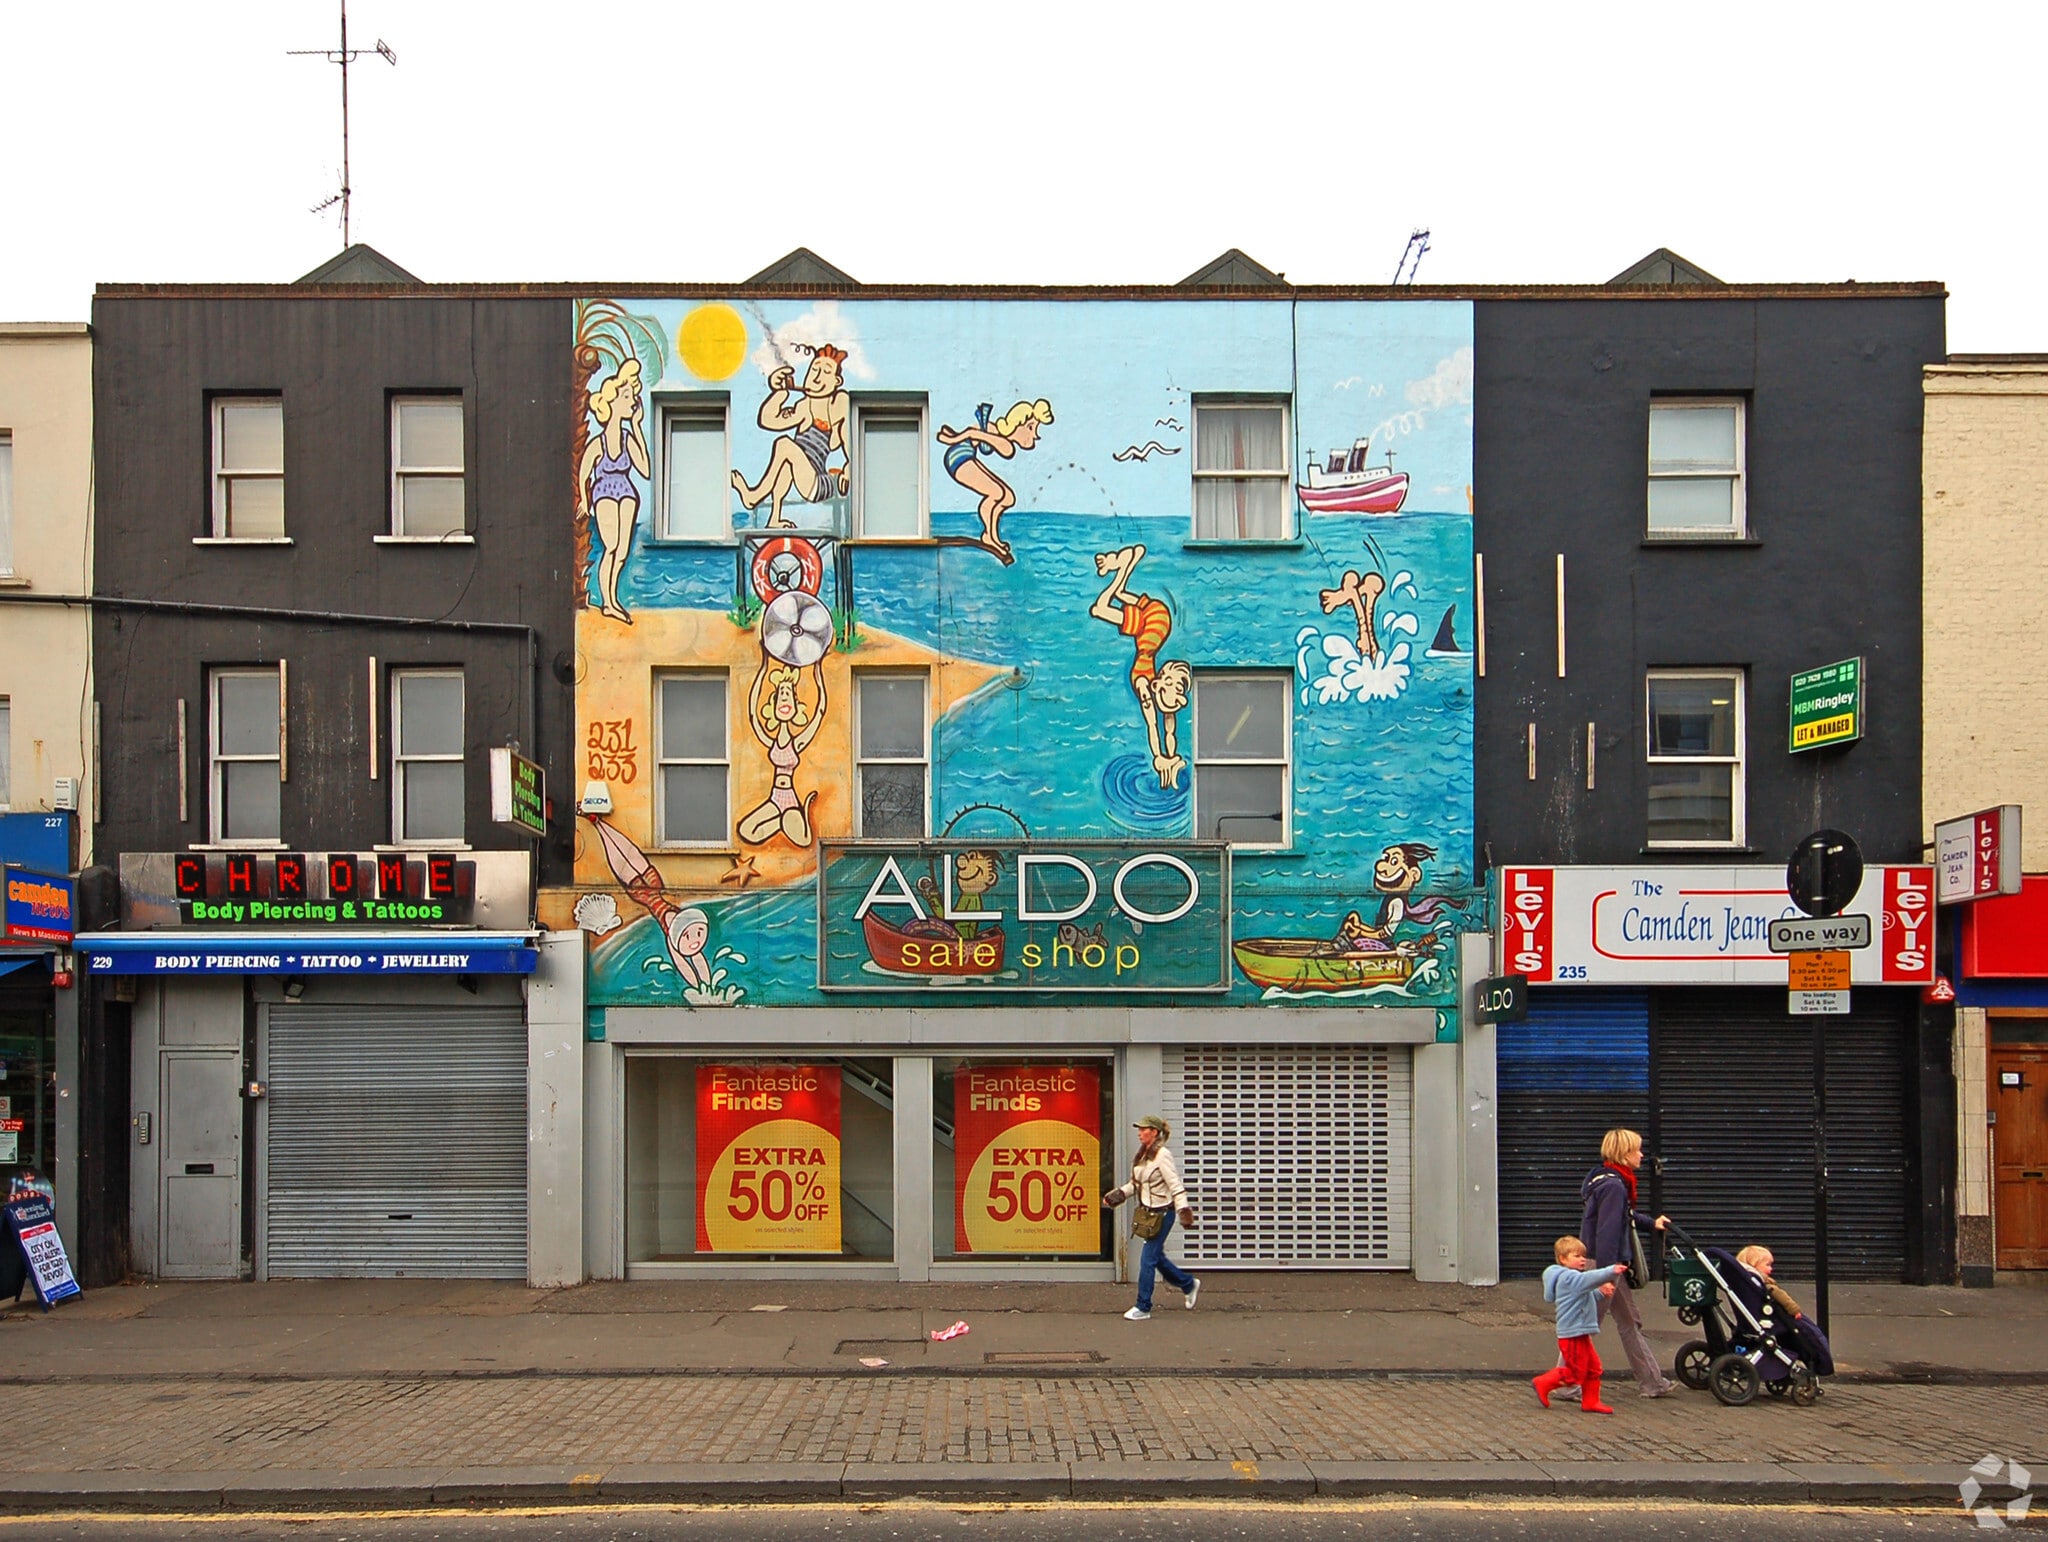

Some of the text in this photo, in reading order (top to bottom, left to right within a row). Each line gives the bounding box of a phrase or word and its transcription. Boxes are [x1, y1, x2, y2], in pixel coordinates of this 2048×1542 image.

[1794, 692, 1855, 715] MBMRingley
[587, 718, 637, 753] 231
[1797, 728, 1808, 742] LET
[1817, 718, 1849, 737] MANAGED
[519, 761, 535, 788] Body
[588, 751, 637, 784] 233
[515, 780, 540, 811] Piercing
[45, 818, 63, 827] 227
[520, 804, 544, 830] Tattoos
[1981, 820, 1993, 890] Levi's
[177, 860, 452, 892] CHROME
[8, 880, 68, 908] camden
[852, 852, 1200, 922] ALDO
[1632, 880, 1663, 897] The
[31, 901, 70, 919] news
[193, 902, 443, 921] Body Piercing & Tattoos
[1514, 873, 1544, 972] Levi's
[1622, 902, 1768, 951] Camden Jean
[1895, 872, 1927, 971] Levi's
[12, 927, 30, 937] News
[38, 930, 69, 941] Magazines
[1778, 927, 1860, 943] One way
[92, 956, 113, 969] 229
[155, 955, 470, 969] BODY PIERCING TATTOO JEWELLERY
[901, 938, 997, 968] sale
[1021, 937, 1141, 975] shop
[1558, 966, 1587, 978] 235
[1478, 988, 1513, 1013] ALDO
[712, 1074, 818, 1092] Fantastic
[970, 1074, 1076, 1092] Fantastic
[712, 1093, 783, 1111] Finds
[970, 1094, 1041, 1111] Finds
[734, 1148, 826, 1165] EXTRA
[993, 1149, 1085, 1166] EXTRA
[727, 1170, 829, 1222] 50% OFF
[986, 1170, 1088, 1222] 50% OFF
[31, 1243, 43, 1254] CITY
[31, 1248, 60, 1265] RED ALERT
[39, 1261, 51, 1273] FOR
